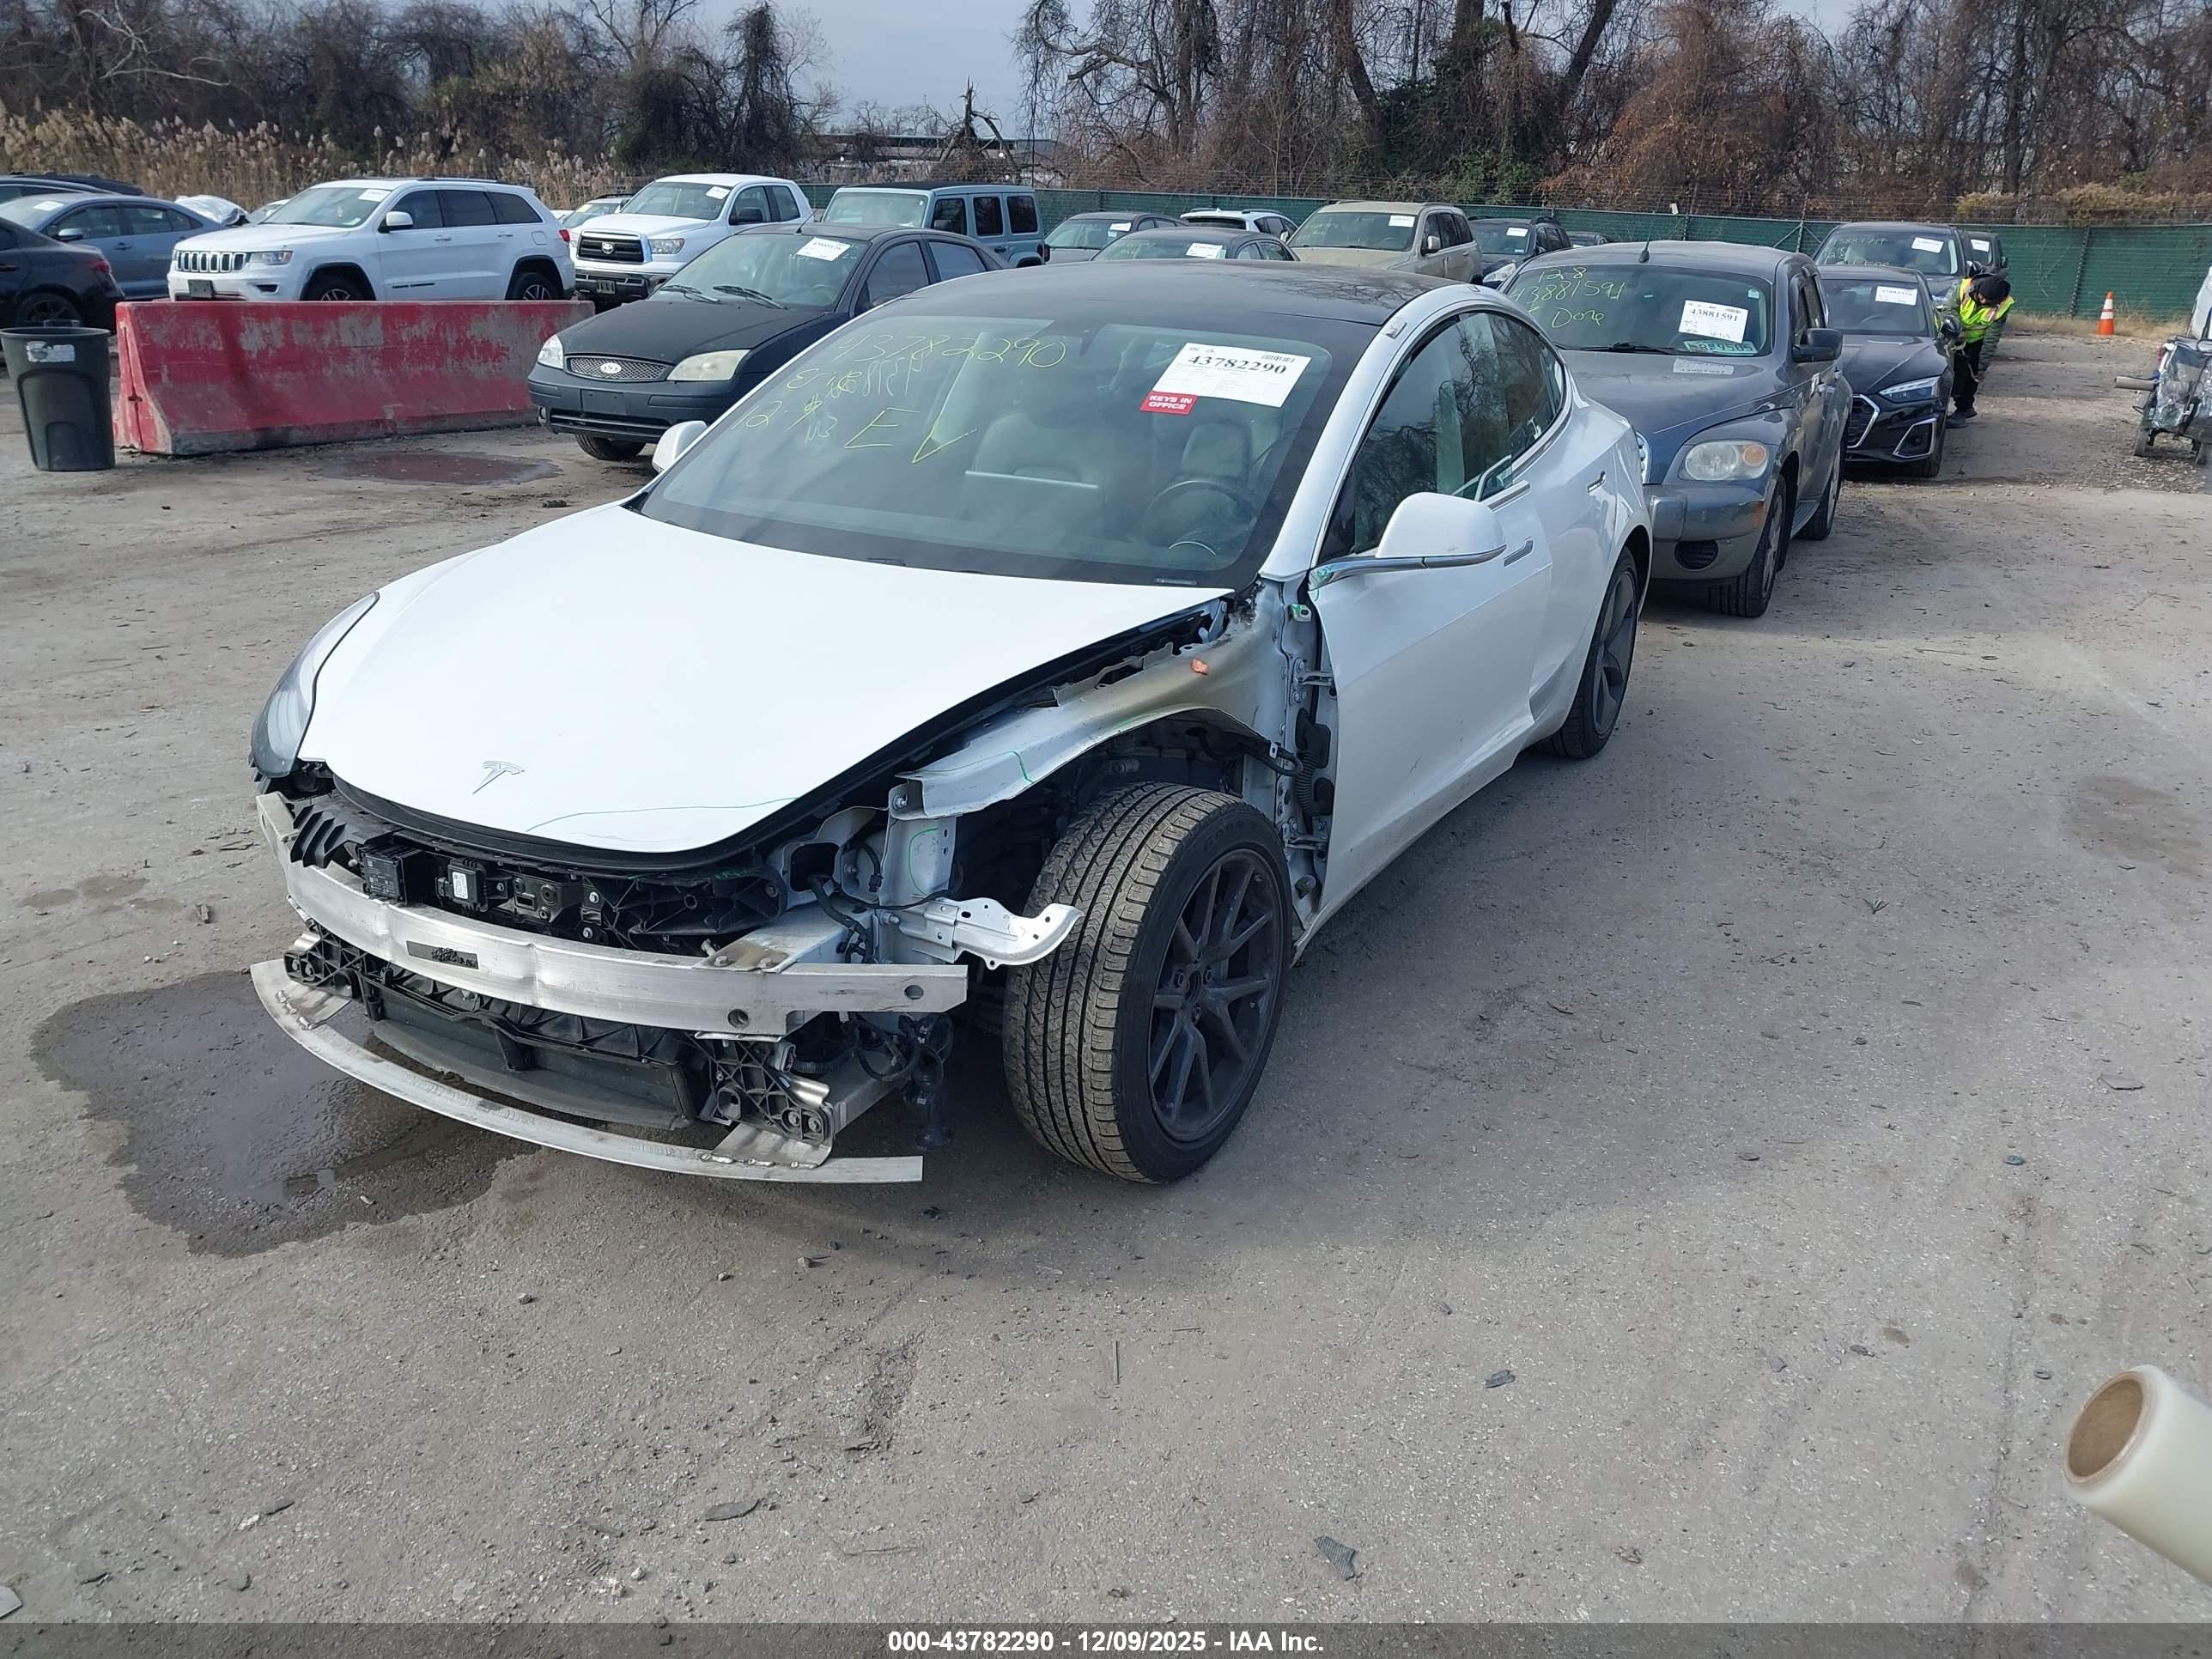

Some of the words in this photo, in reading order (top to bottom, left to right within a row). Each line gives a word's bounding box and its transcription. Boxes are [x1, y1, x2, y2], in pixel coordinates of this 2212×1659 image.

[1510, 280, 1626, 304] 43881591
[1552, 307, 1605, 328] Done
[1689, 308, 1739, 322] 43881591
[1188, 354, 1288, 375] 43782290
[1148, 394, 1177, 404] KEYS
[1180, 396, 1193, 404] IN
[1148, 400, 1187, 410] OFFICE
